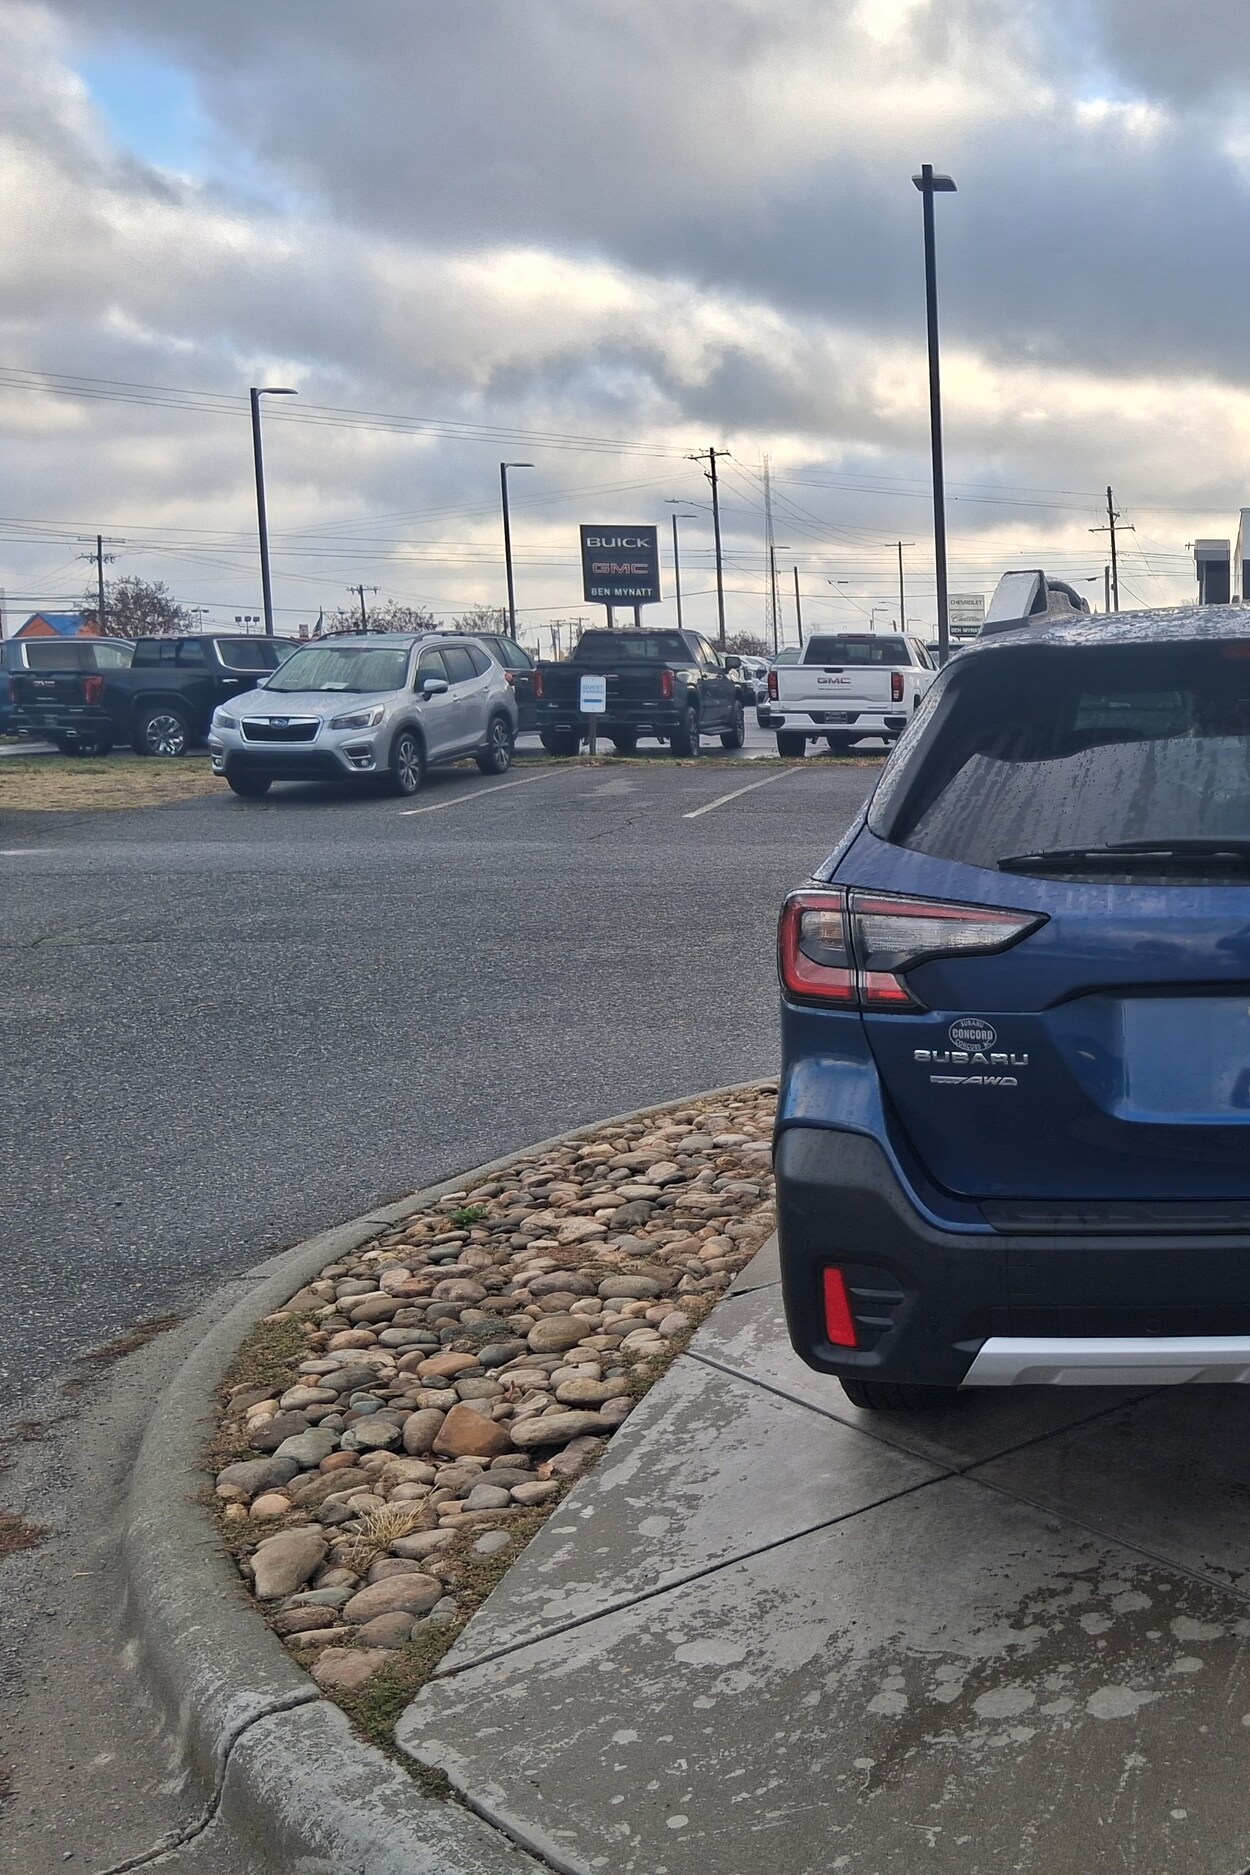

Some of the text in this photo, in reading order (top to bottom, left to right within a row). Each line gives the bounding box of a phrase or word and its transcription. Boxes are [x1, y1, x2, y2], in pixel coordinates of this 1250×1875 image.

[587, 537, 651, 548] BUICK
[592, 562, 649, 575] GMC
[591, 587, 653, 597] BEN MYNATT
[817, 677, 851, 685] GMC
[952, 1029, 993, 1040] CONCORD
[913, 1049, 1029, 1066] SUBARU
[962, 1075, 1018, 1086] AWD
